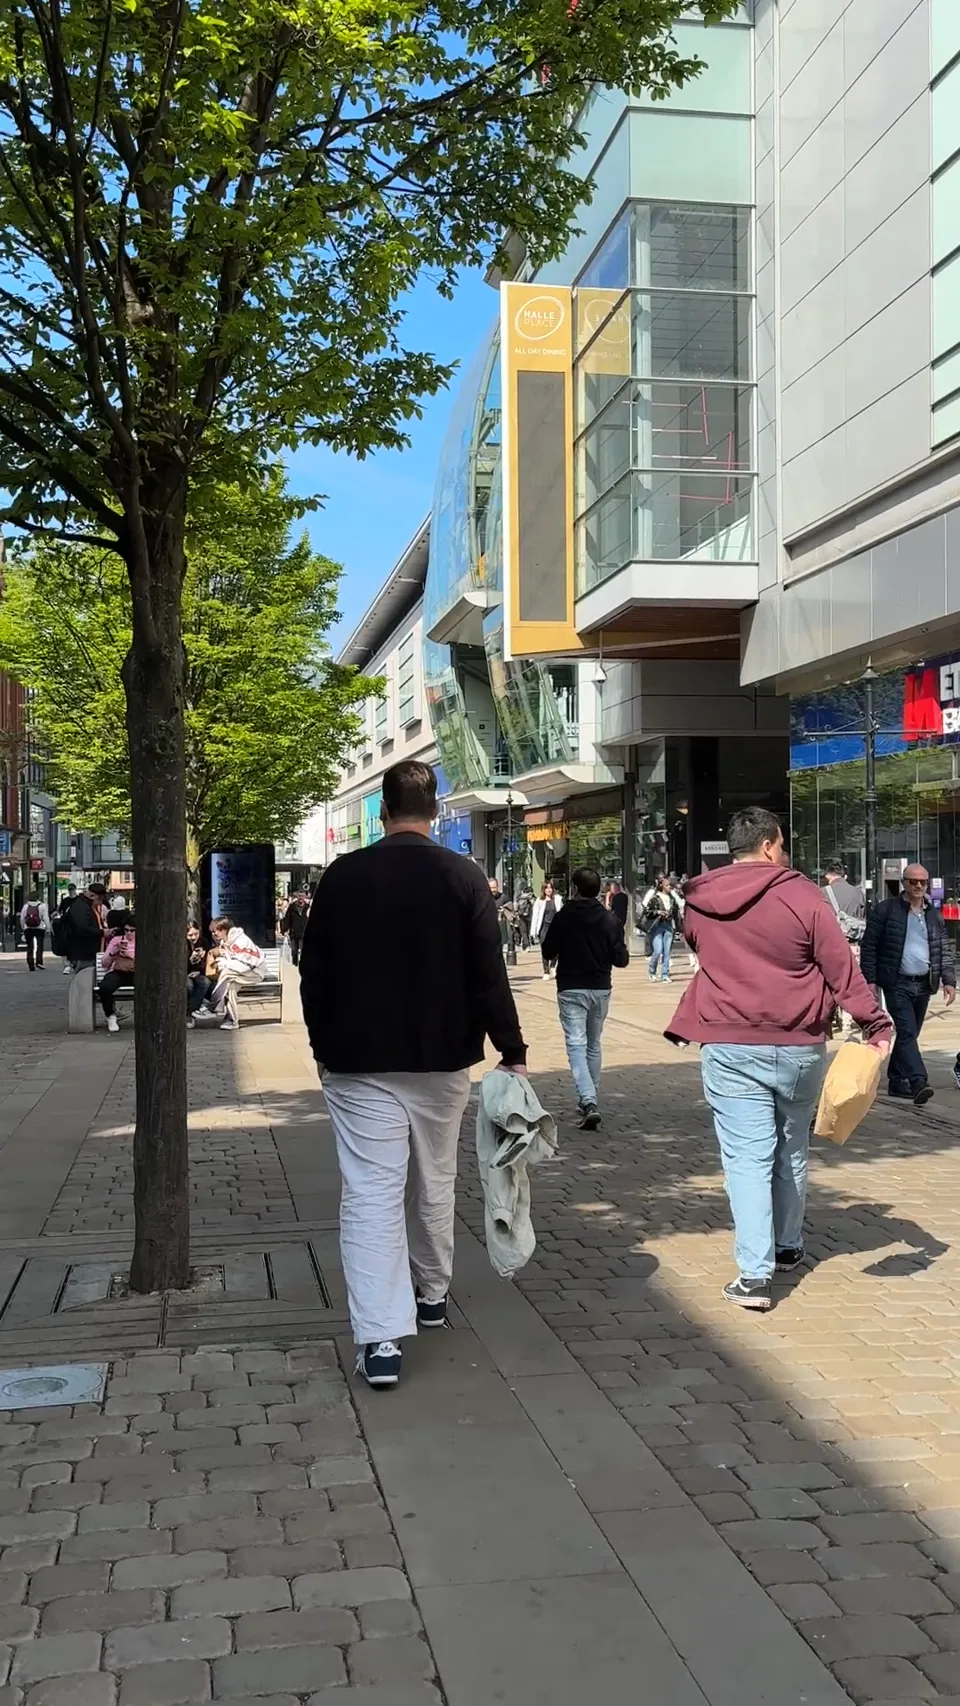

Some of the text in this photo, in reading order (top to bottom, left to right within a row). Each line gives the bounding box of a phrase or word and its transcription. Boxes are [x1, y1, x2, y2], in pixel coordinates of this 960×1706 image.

[523, 310, 556, 319] HALLE
[523, 319, 555, 328] PLACE
[514, 347, 567, 356] ALL DAY DINING
